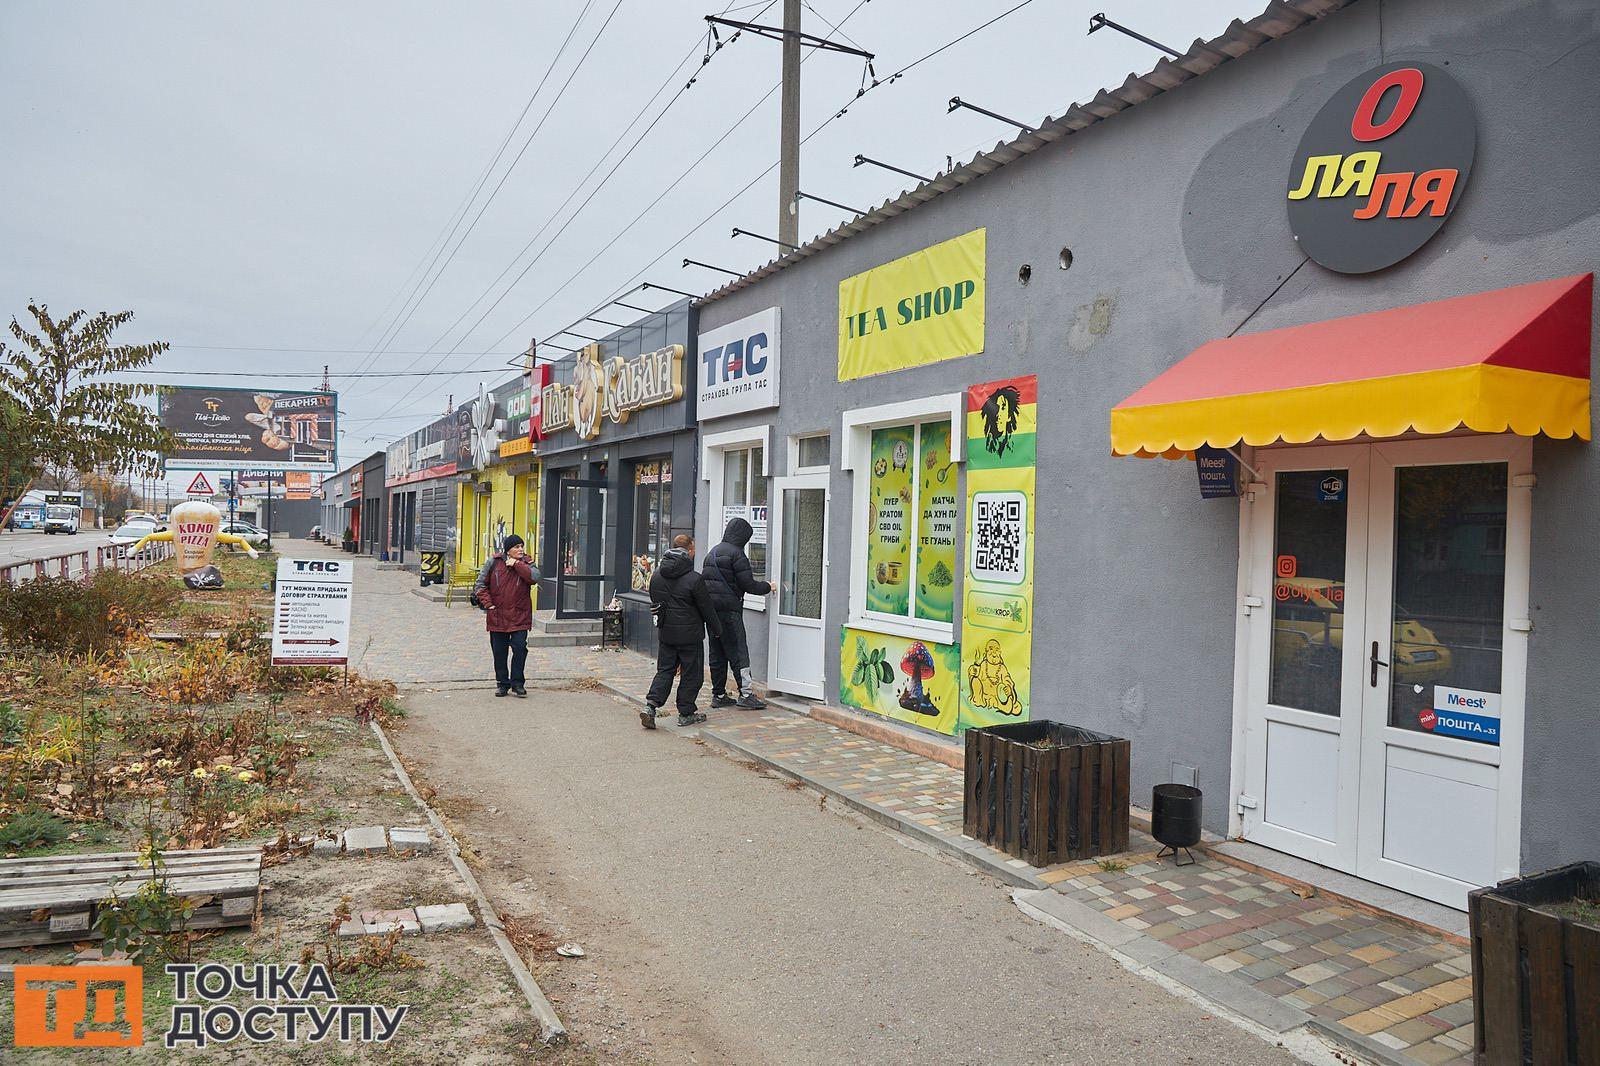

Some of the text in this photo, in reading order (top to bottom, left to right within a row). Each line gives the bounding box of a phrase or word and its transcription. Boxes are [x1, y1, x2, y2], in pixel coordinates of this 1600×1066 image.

[1288, 151, 1382, 200] ЛЯ
[1353, 168, 1459, 220] ЛЯ
[846, 279, 975, 339] TEA SHOP
[703, 332, 768, 387] ТАС
[601, 350, 675, 418] КАБАН
[701, 379, 768, 402] СТРАХОВА ГРУПА ТАС
[274, 397, 318, 408] ПЕКАРНЯ
[1200, 472, 1226, 480] ПОШТА
[883, 498, 899, 506] ПУЕР
[931, 496, 955, 505] МАТЧА
[923, 510, 933, 519] ДА
[934, 511, 948, 519] ХУН
[179, 523, 214, 534] KONO
[879, 523, 902, 531] CBD OIL
[933, 523, 951, 532] УЛУН
[180, 536, 209, 548] PIZZA
[880, 535, 900, 543] ГРИБИ
[921, 536, 929, 545] ТЕ
[930, 537, 952, 545] ГУАНЬ
[293, 560, 340, 573] ТАС
[1447, 693, 1484, 708] Meest
[1420, 713, 1435, 723] mini
[1437, 716, 1482, 733] ПОШТА
